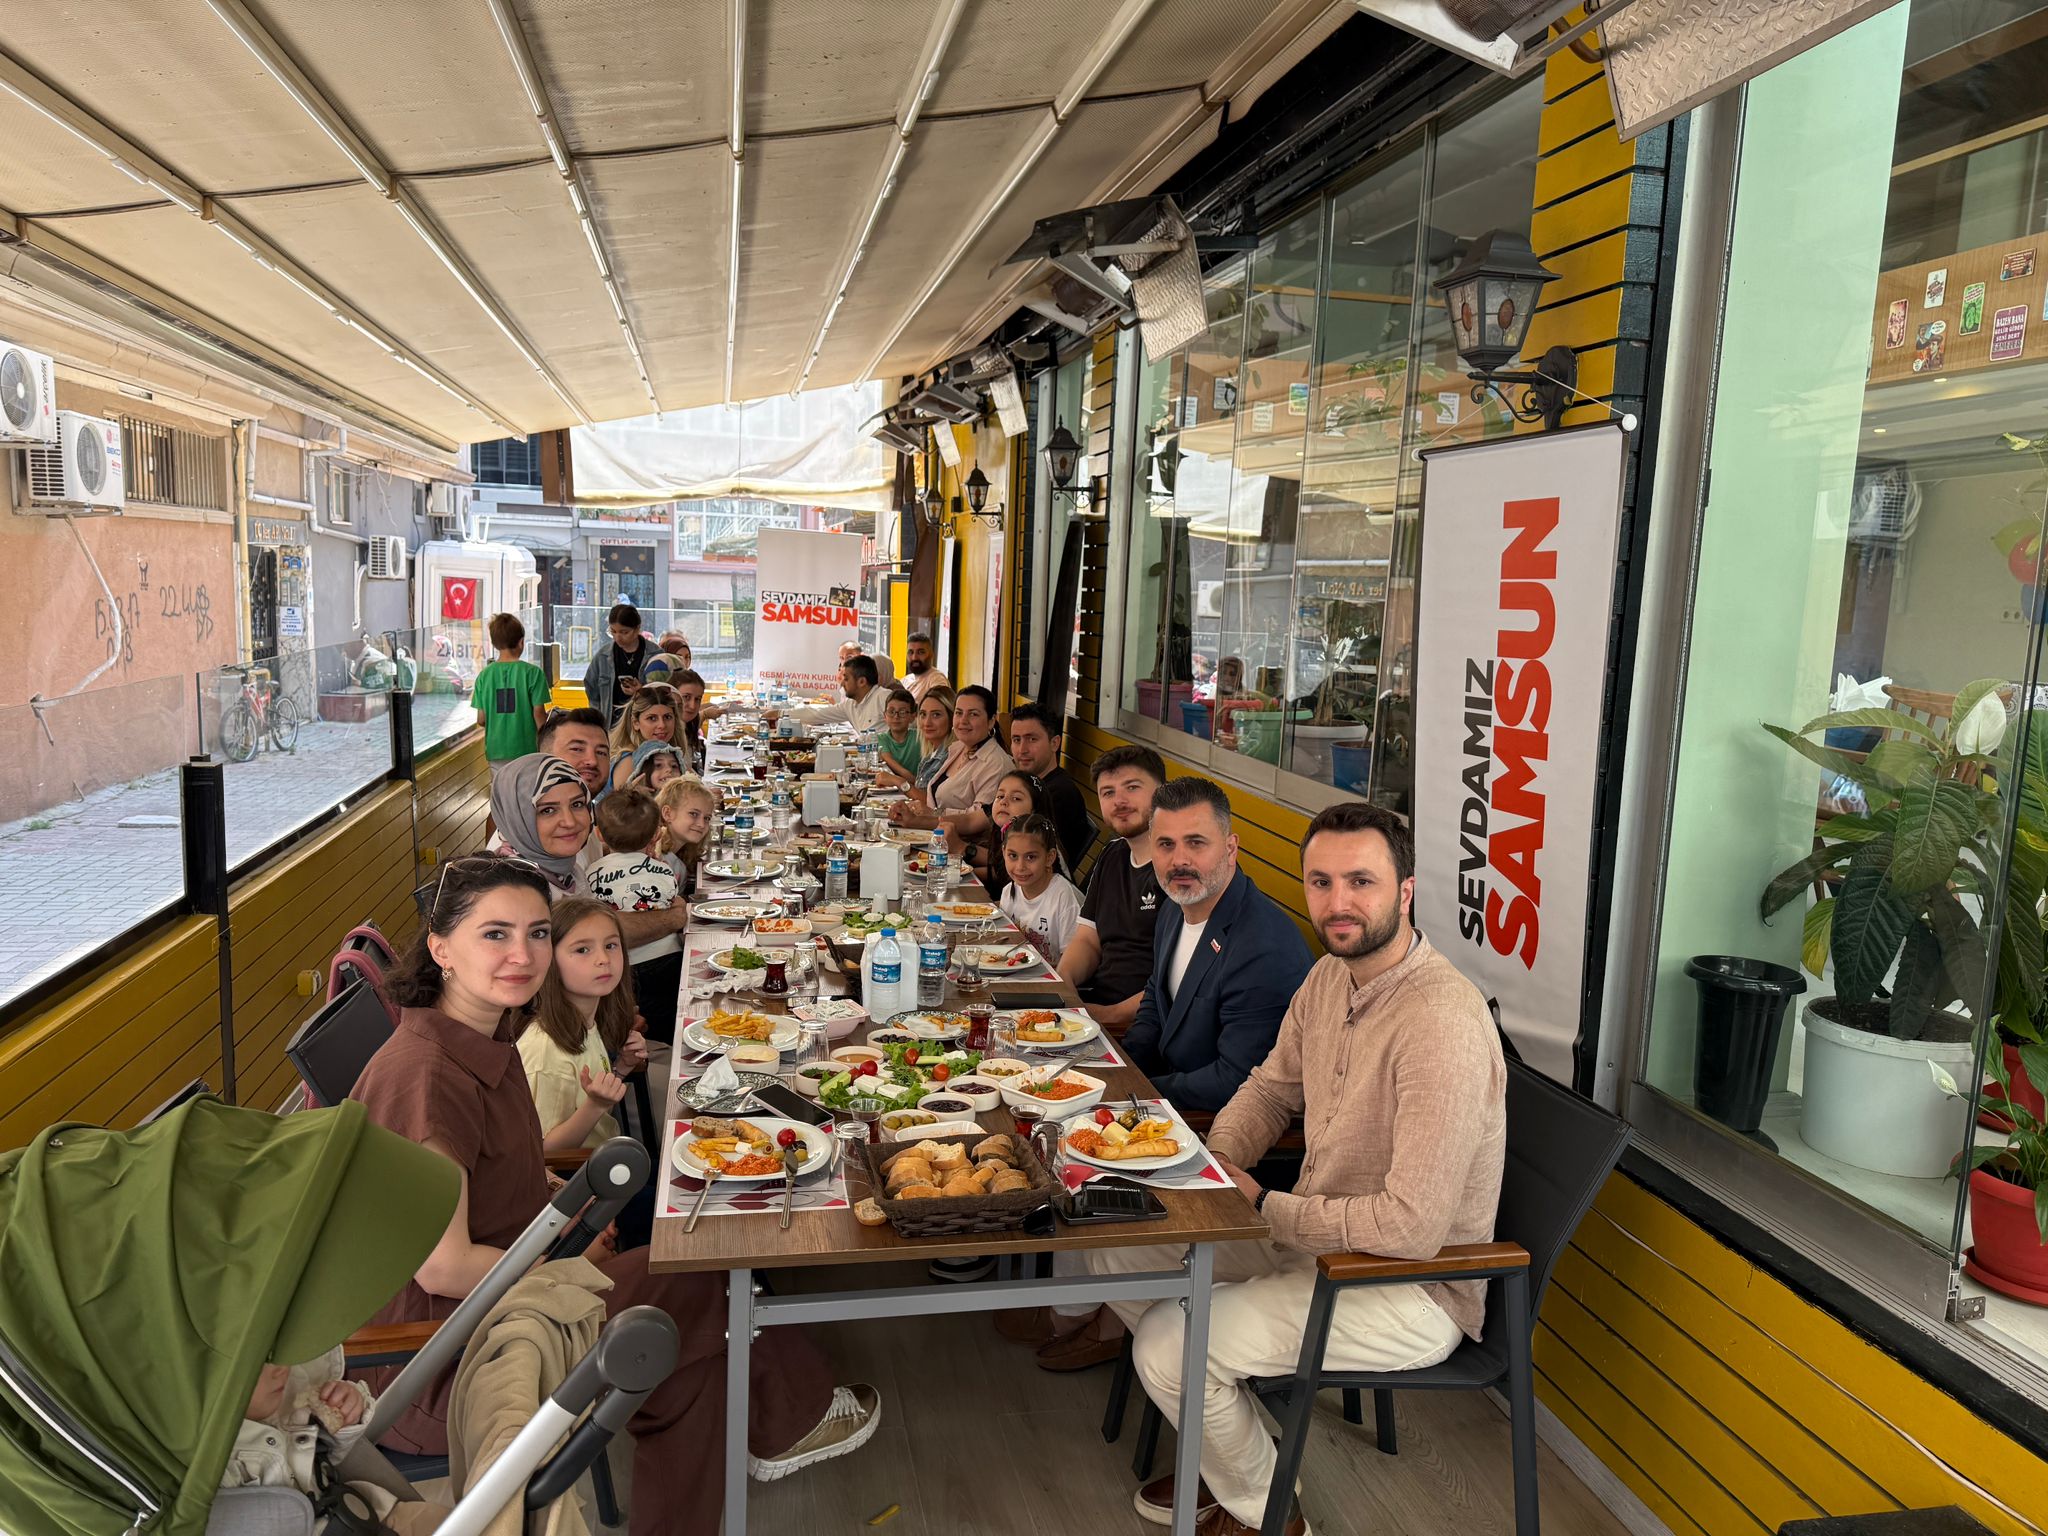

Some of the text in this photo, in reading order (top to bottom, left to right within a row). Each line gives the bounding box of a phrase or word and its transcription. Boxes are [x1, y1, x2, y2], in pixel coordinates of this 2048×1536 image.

[762, 591, 827, 606] SEVDAMIZ
[762, 602, 858, 628] SAMSUN
[1459, 657, 1494, 949] SEVDAMIZ
[1485, 496, 1560, 972] SAMSUN
